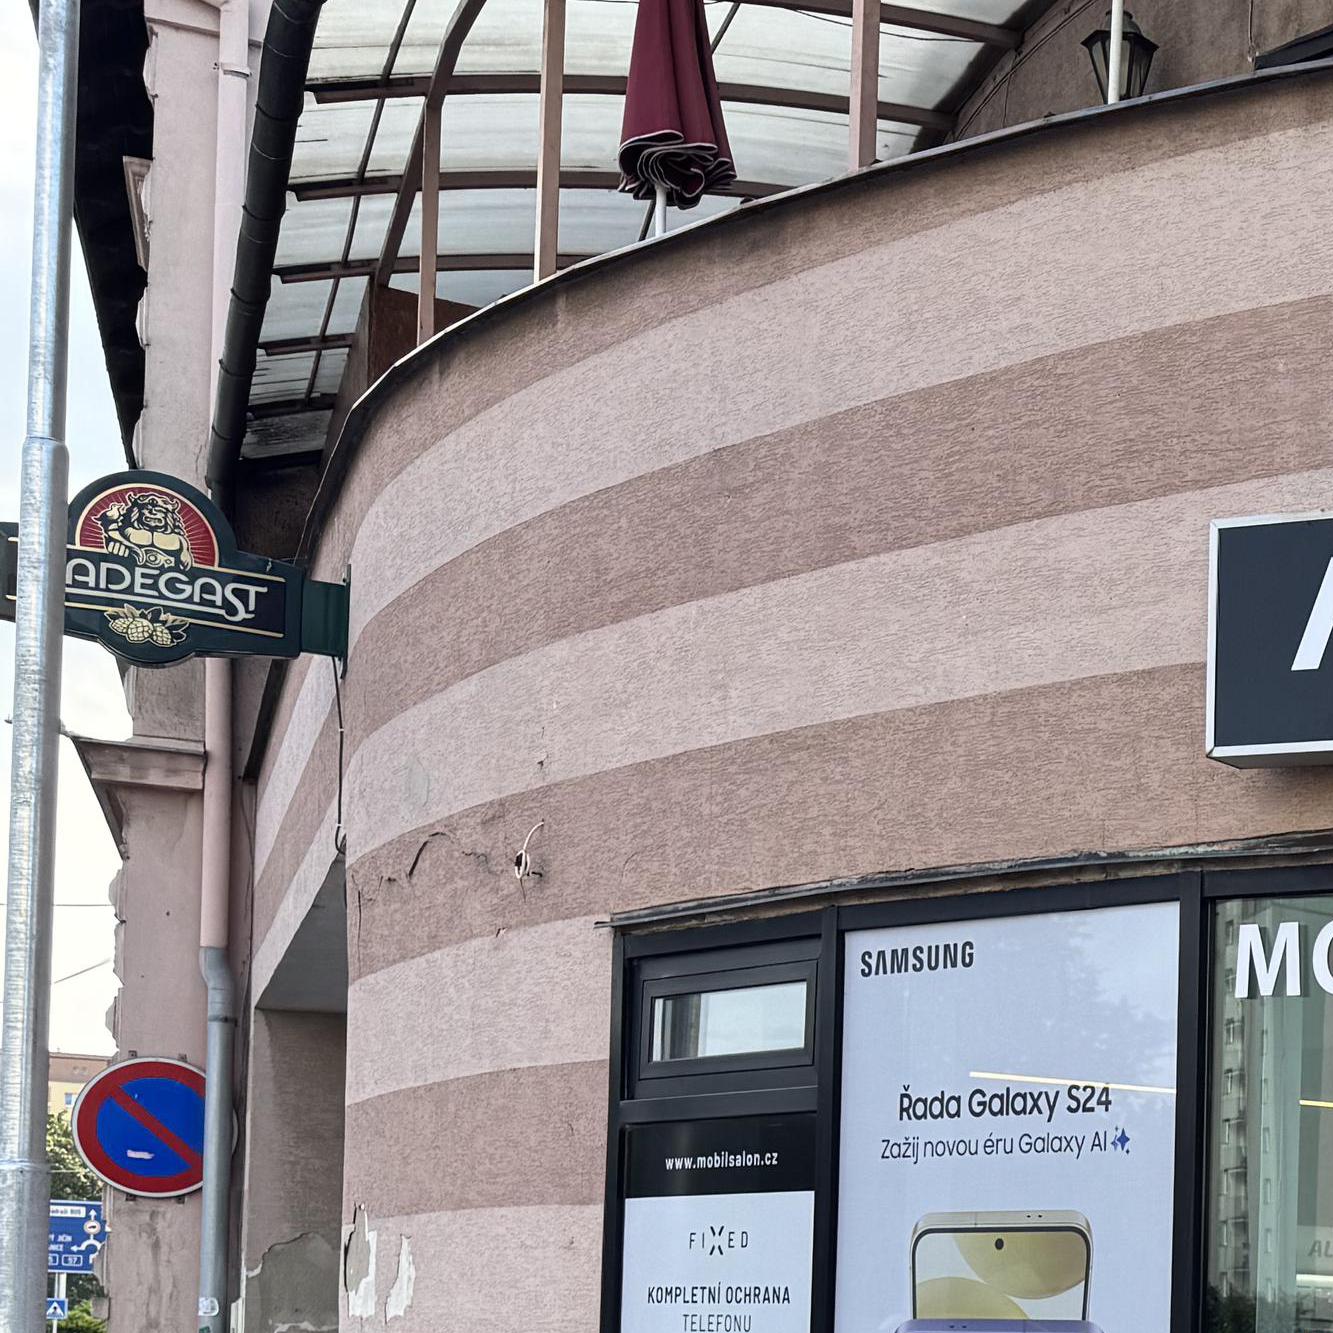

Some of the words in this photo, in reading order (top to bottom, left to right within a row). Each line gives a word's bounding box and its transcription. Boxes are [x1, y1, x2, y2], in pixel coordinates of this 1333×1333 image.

[66, 557, 268, 621] ADEGAST
[860, 940, 975, 978] SAMSUNG
[899, 1083, 961, 1121] Řada
[968, 1087, 1059, 1123] Galaxy
[1066, 1083, 1113, 1114] S24
[665, 1150, 778, 1171] www.mobilsalon.cz
[880, 1137, 919, 1165] Zažij
[924, 1138, 978, 1158] novou
[984, 1133, 1014, 1156] éru
[1018, 1131, 1084, 1162] Galaxy
[1089, 1130, 1107, 1153] AI
[689, 1225, 748, 1256] FIXED
[647, 1282, 721, 1305] KOMPLETNÍ
[725, 1285, 791, 1305] OCHRANA
[682, 1313, 751, 1333] TELEFONU
